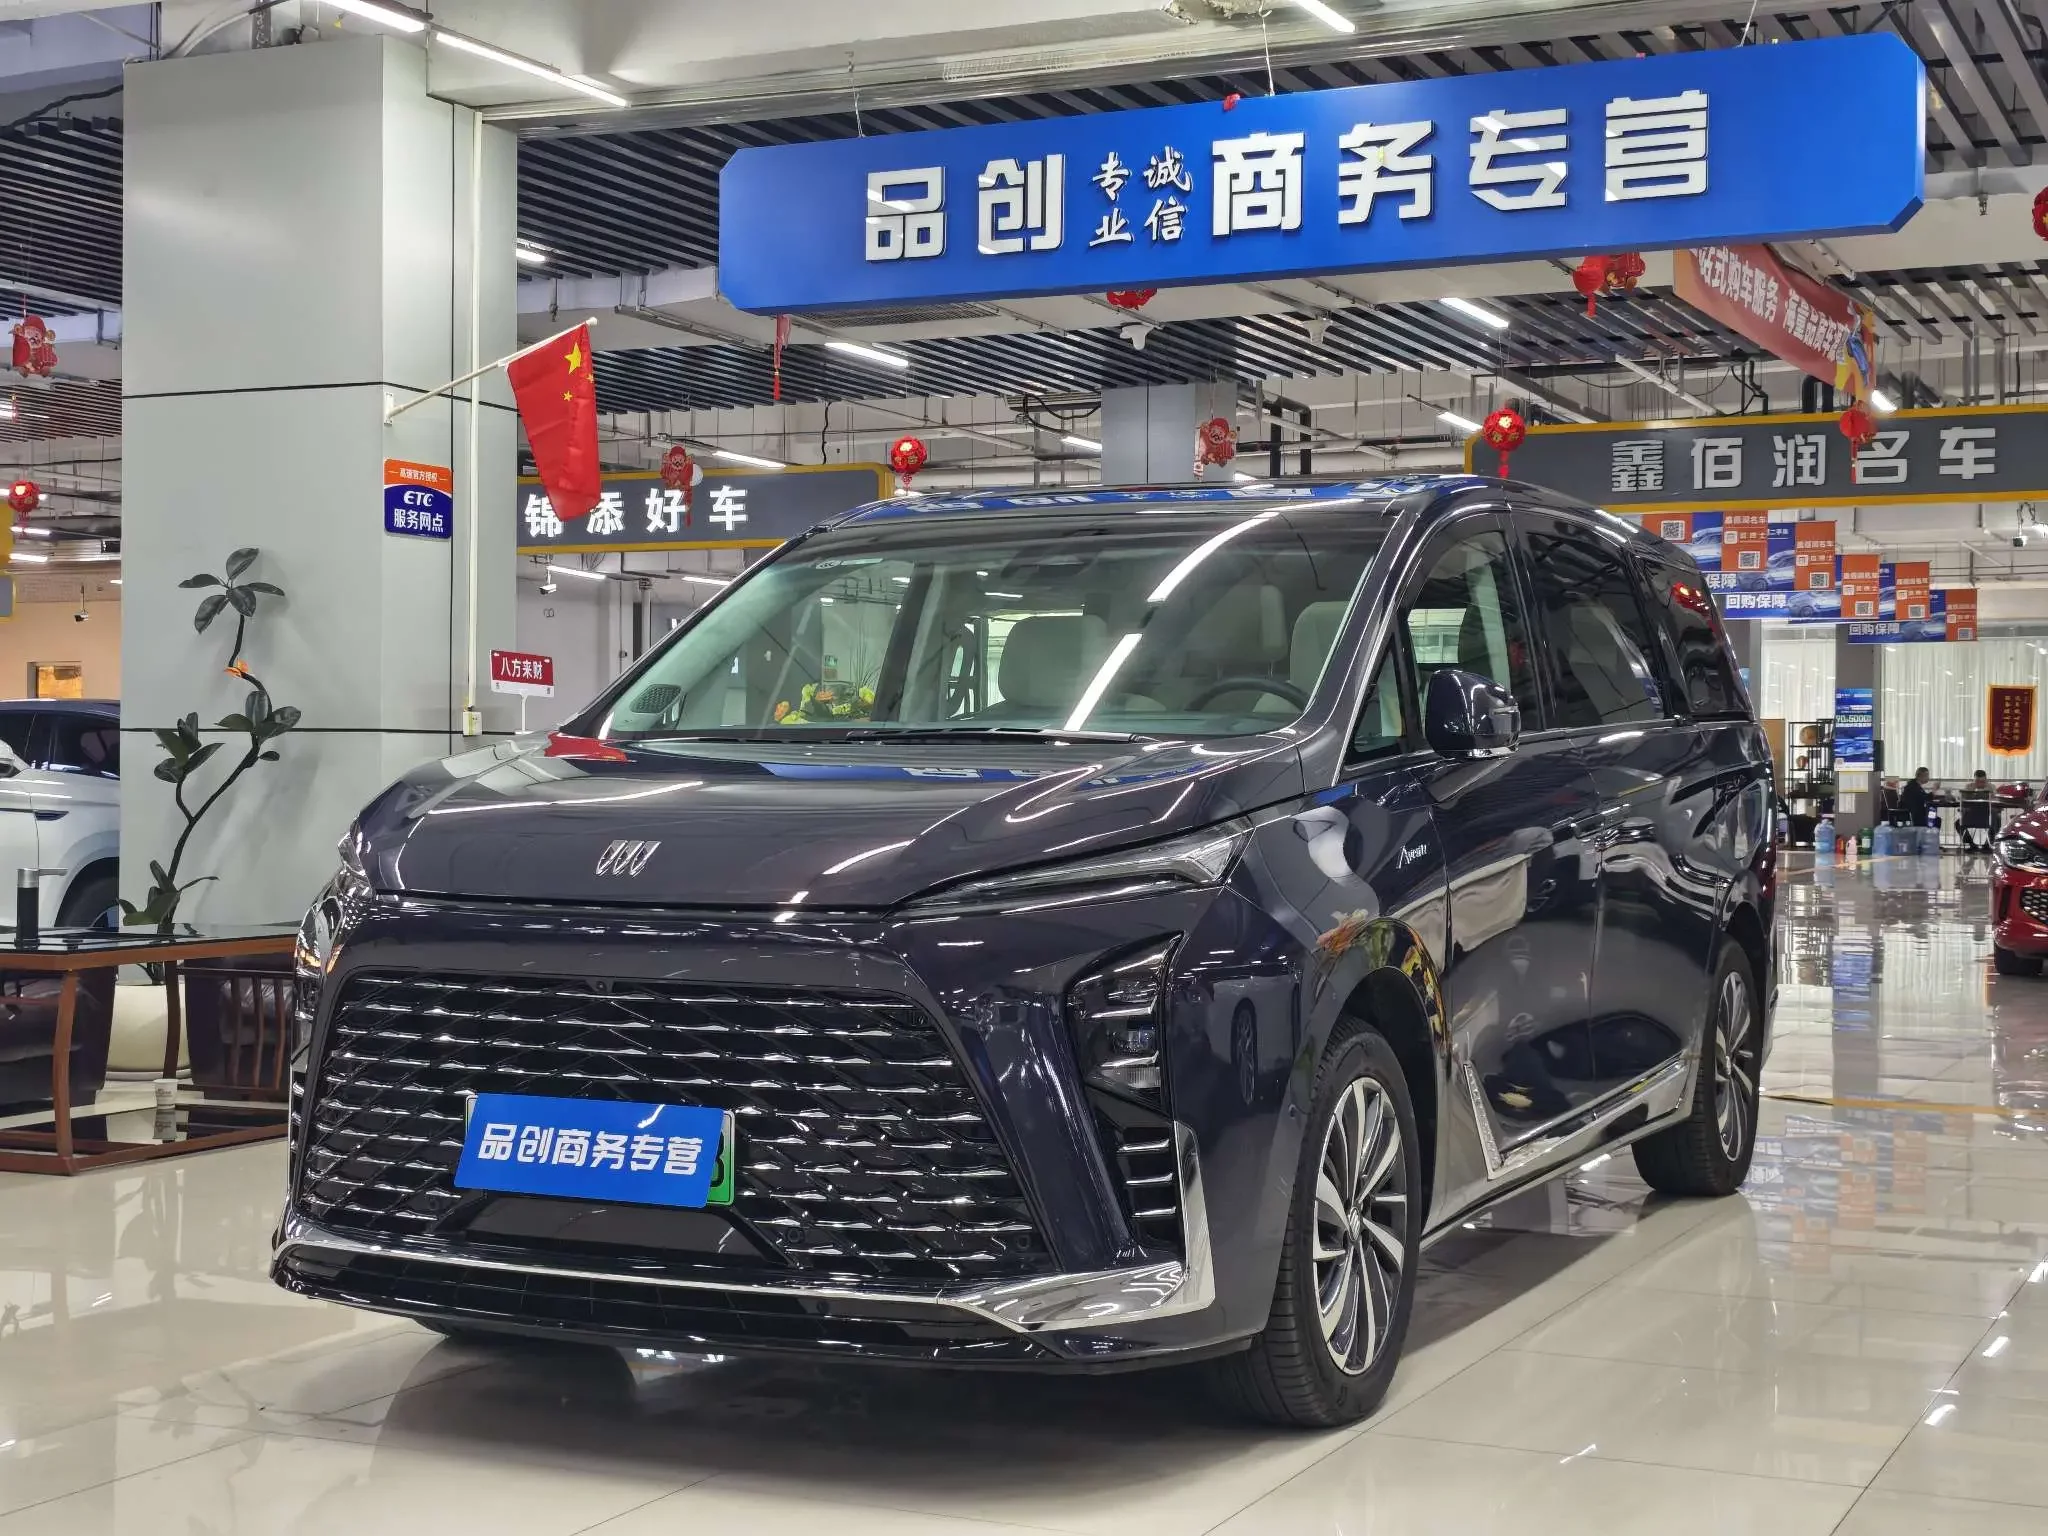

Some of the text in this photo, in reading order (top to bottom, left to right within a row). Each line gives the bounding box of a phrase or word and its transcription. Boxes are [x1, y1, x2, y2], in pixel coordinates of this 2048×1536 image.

[865, 153, 1066, 262] 品创
[1211, 89, 1709, 237] 商务专营
[1689, 245, 1778, 323] 站式购车服务
[1611, 426, 1997, 493] 鑫佰润名车
[403, 490, 434, 507] ETC
[393, 508, 444, 533] 服务网点
[1725, 594, 1787, 609] 回购保障
[501, 657, 543, 680] 八方来财
[477, 1122, 703, 1176] 品创商务专营
